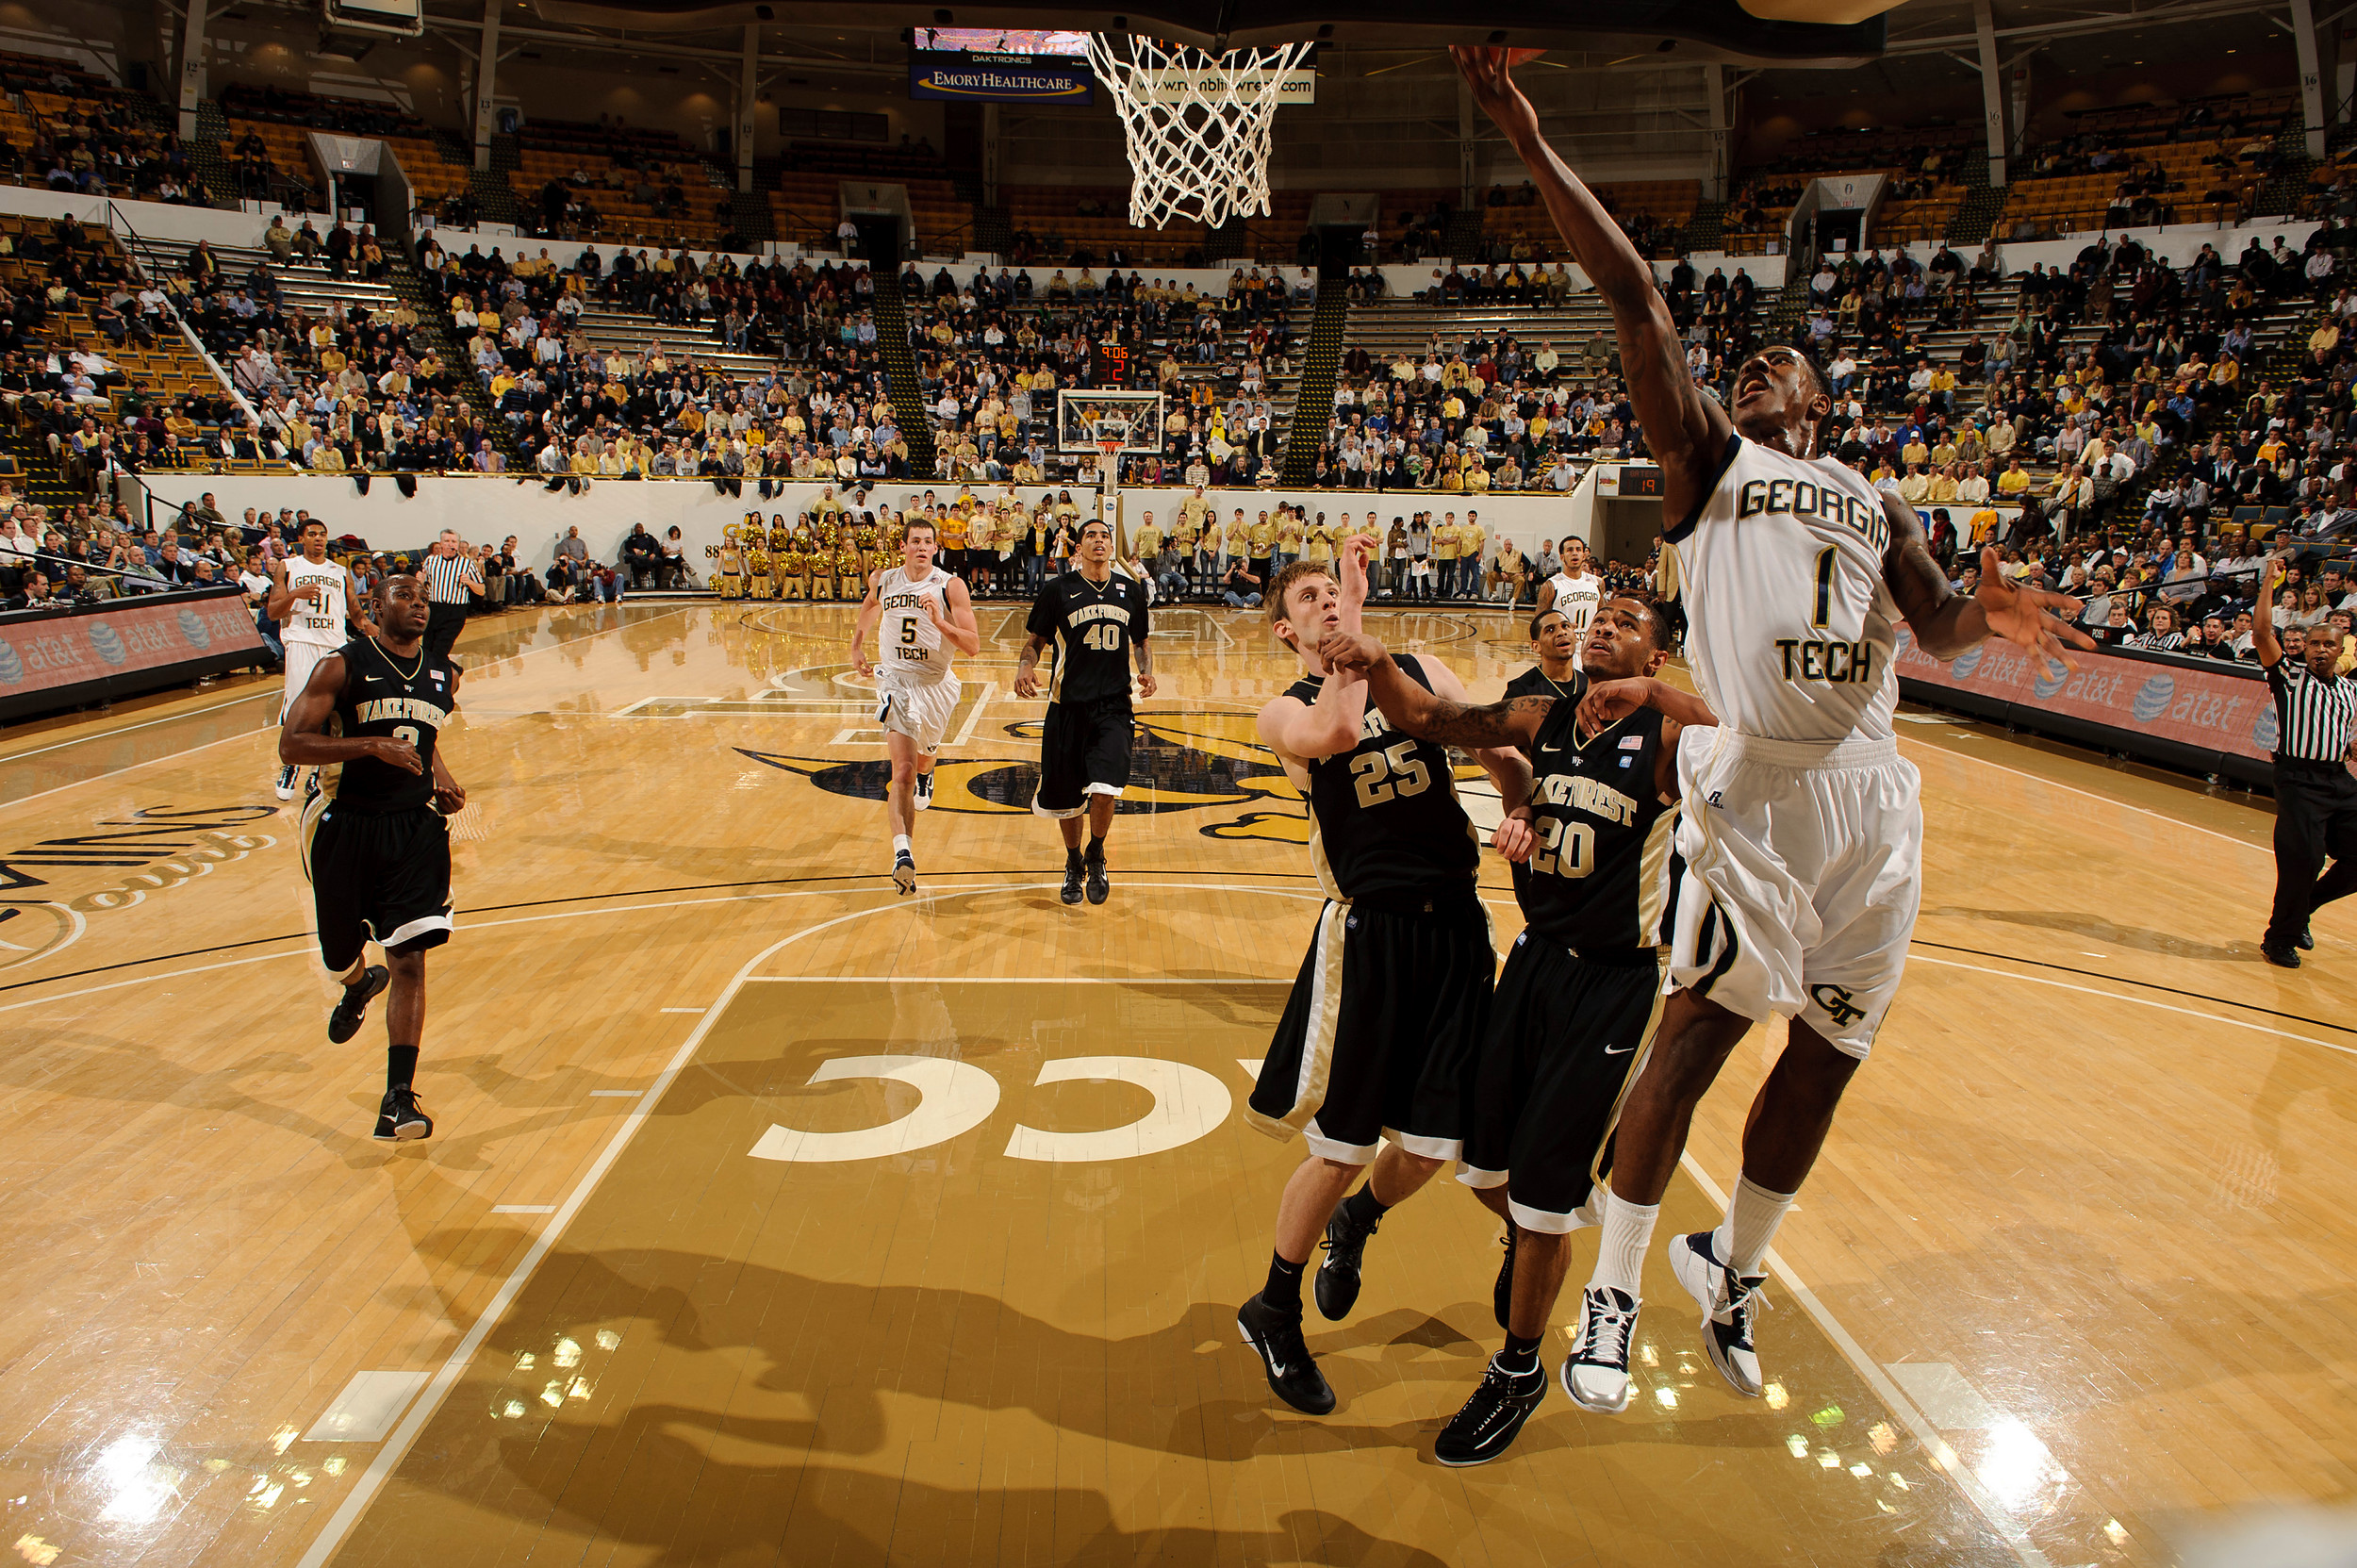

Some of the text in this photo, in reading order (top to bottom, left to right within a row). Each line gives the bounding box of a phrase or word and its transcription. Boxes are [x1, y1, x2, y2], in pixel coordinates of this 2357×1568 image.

[972, 55, 1031, 64] DAKTRONICS
[933, 71, 1072, 91] EMORY HEALTHCARE
[2304, 75, 2317, 86] 16
[480, 100, 490, 109] 13
[1989, 111, 2000, 122] 16
[1102, 346, 1129, 358] 9:06
[1640, 479, 1655, 492] 19
[1739, 478, 1889, 555] GEORGIA
[295, 574, 341, 592] GEORGIA
[1811, 543, 1838, 629] 1
[883, 594, 927, 612] GEORG
[1560, 591, 1599, 607] GEORGIA
[208, 604, 251, 638] at&t
[305, 618, 334, 629] TECH
[1067, 605, 1097, 629] WAKE
[1575, 608, 1588, 629] 11
[128, 617, 175, 652] at&t
[901, 617, 918, 644] 5
[1083, 624, 1120, 651] 40
[2091, 628, 2105, 639] POSS
[28, 632, 84, 668] at&t
[895, 646, 929, 661] TECH
[1774, 638, 1871, 685] TECH
[1980, 653, 2028, 686] at&t
[2066, 669, 2123, 706] at&t
[355, 697, 403, 724] WAKE
[2173, 687, 2241, 734] at&t
[1348, 739, 1431, 809] 25
[1533, 816, 1594, 878] 20
[1810, 983, 1868, 1029] GT
